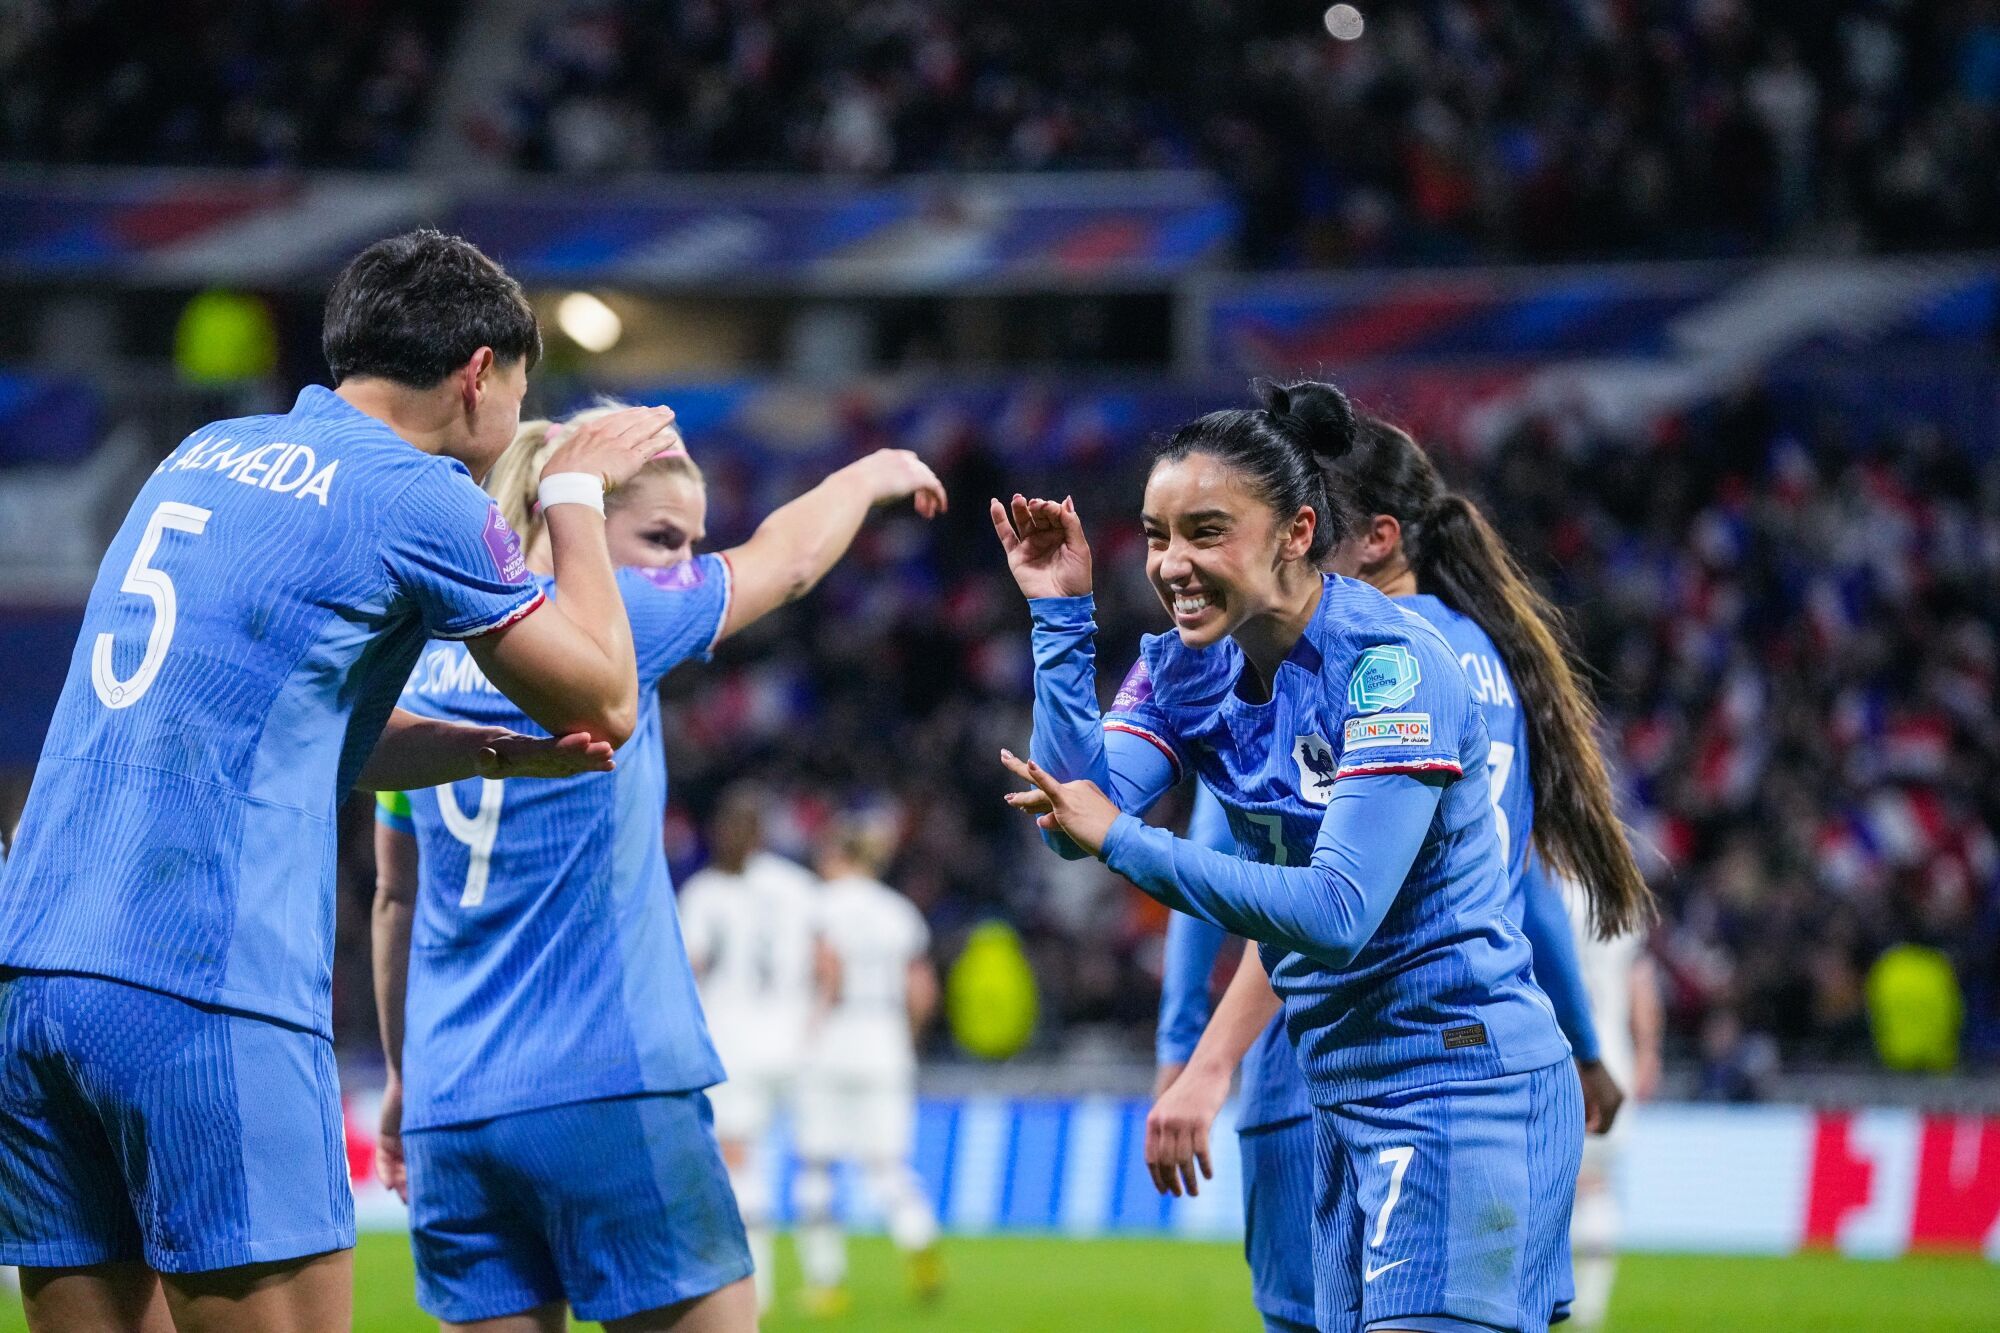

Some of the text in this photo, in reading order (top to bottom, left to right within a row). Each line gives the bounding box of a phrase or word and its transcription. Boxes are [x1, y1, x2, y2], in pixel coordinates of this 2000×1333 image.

[169, 435, 340, 506] ALMEIDA
[91, 501, 213, 709] 5
[1366, 673, 1384, 684] play
[1368, 677, 1397, 689] strong
[1346, 723, 1429, 738] FOUNDATION
[1371, 1146, 1415, 1248] 7
